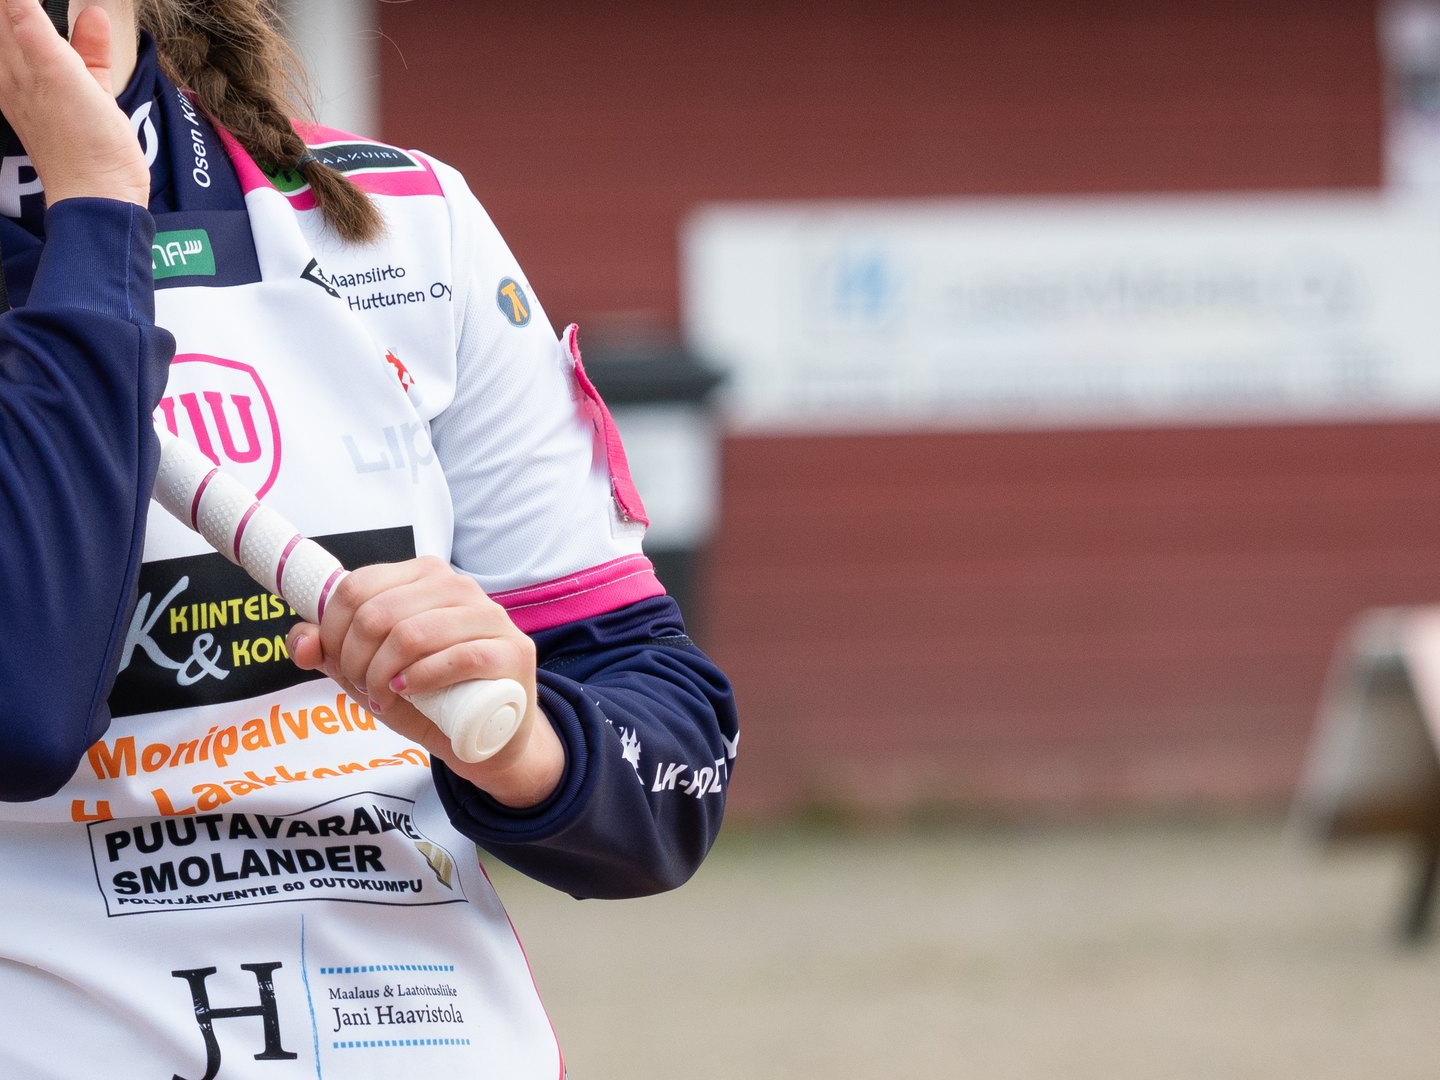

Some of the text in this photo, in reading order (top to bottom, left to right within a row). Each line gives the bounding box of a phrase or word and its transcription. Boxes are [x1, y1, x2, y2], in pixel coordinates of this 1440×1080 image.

[192, 132, 211, 188] Osen
[347, 281, 453, 312] Huttunen Oy
[87, 693, 377, 780] Monipalvelu
[112, 845, 387, 896] SMOLANDER
[117, 877, 423, 906] POLVIJÄRVENTIE 60 OUTOKUMPU
[328, 983, 458, 1000] Maalaus & Laatoitusliike
[332, 1003, 465, 1033] Jani Haavistola
